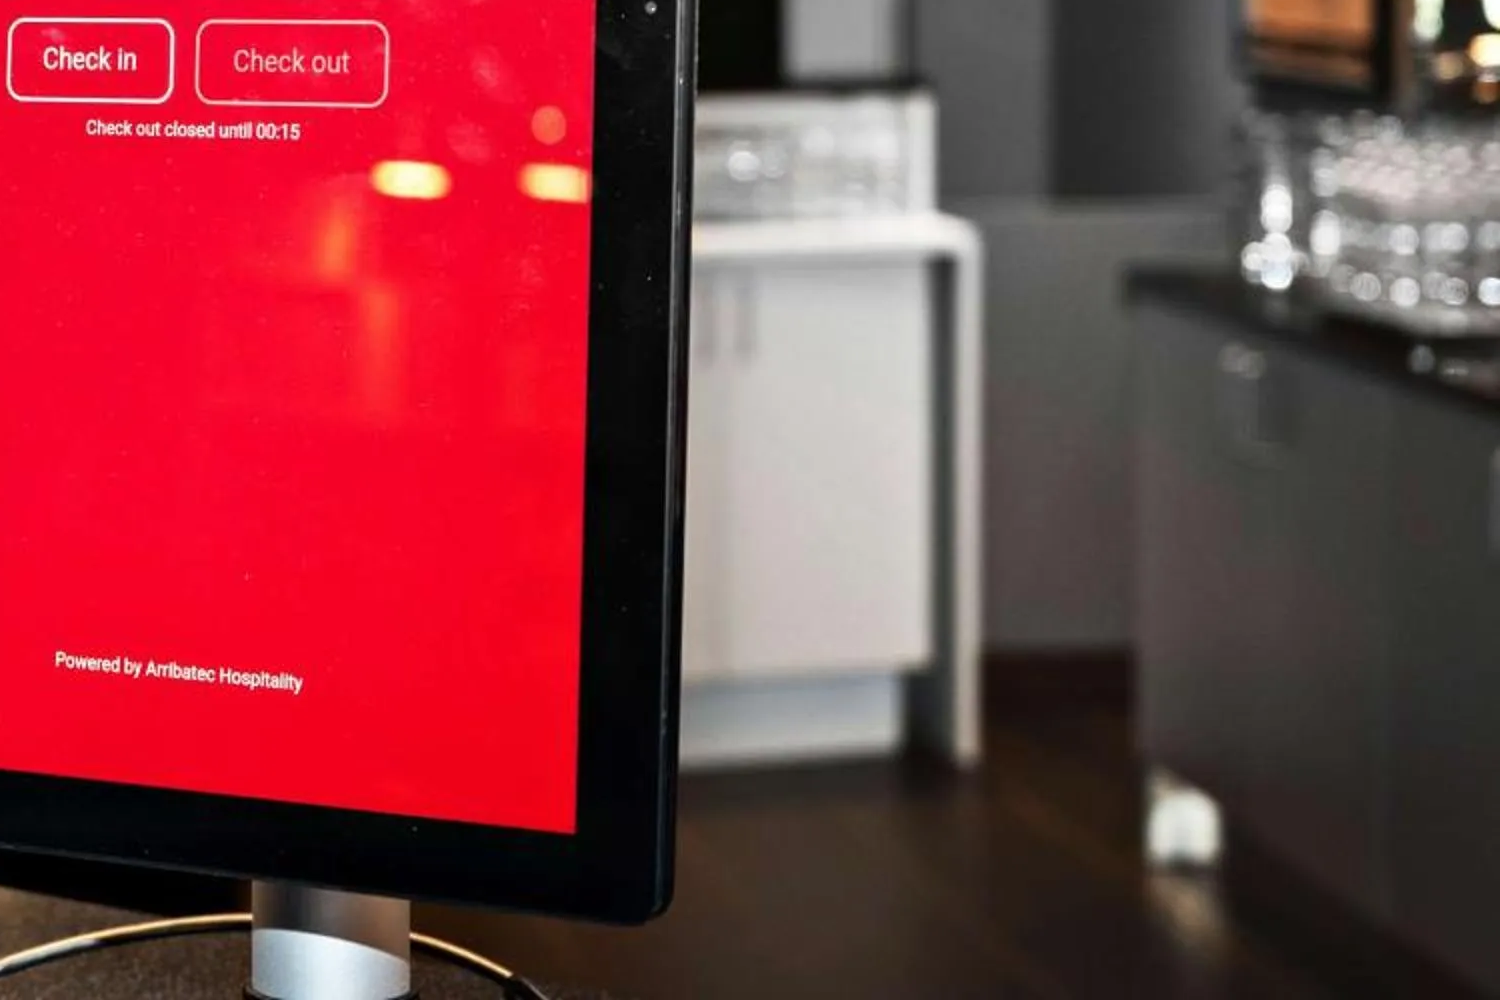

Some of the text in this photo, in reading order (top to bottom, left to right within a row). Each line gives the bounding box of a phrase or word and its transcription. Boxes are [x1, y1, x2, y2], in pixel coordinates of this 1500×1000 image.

[43, 45, 137, 73] Check in
[233, 47, 350, 74] Check out
[86, 119, 301, 141] Check out closed until 00:15
[55, 650, 303, 695] Powered by Arribatec Hospitality
